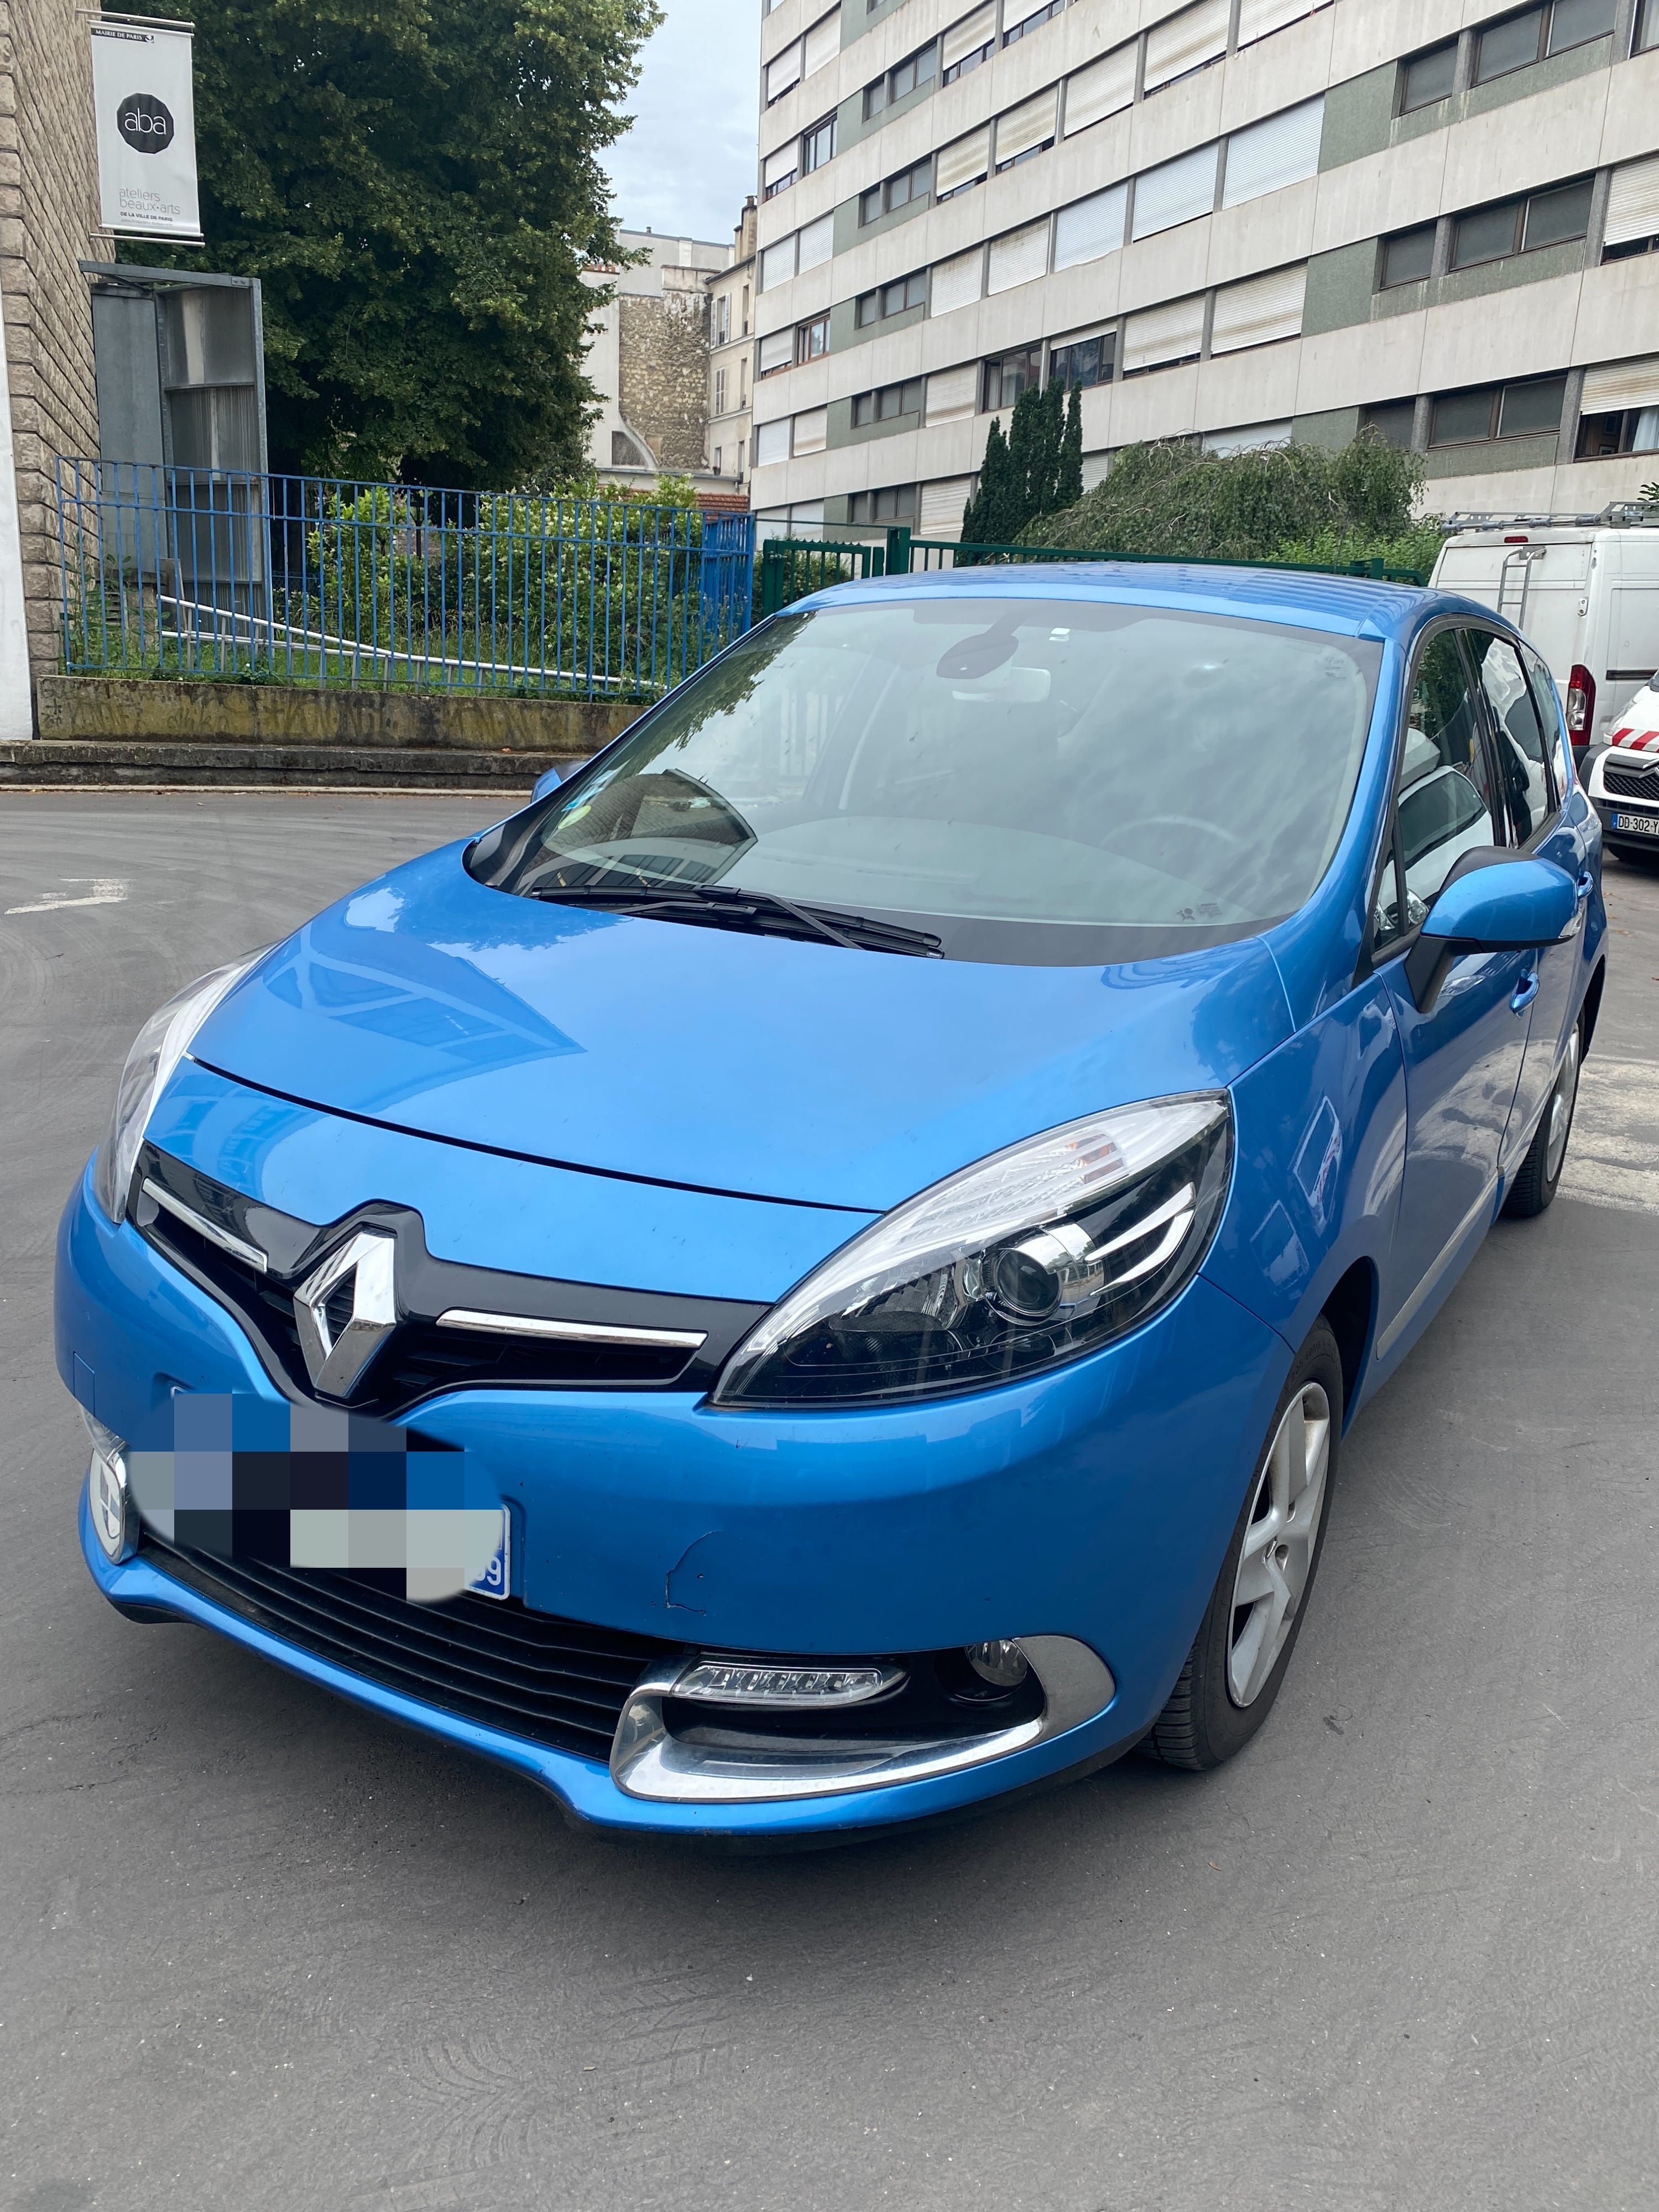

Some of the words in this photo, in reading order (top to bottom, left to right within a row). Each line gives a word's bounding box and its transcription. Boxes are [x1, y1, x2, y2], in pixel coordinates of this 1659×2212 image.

[124, 107, 166, 135] aba
[119, 187, 160, 202] ateliers
[1619, 816, 1659, 833] DD-302-Y
